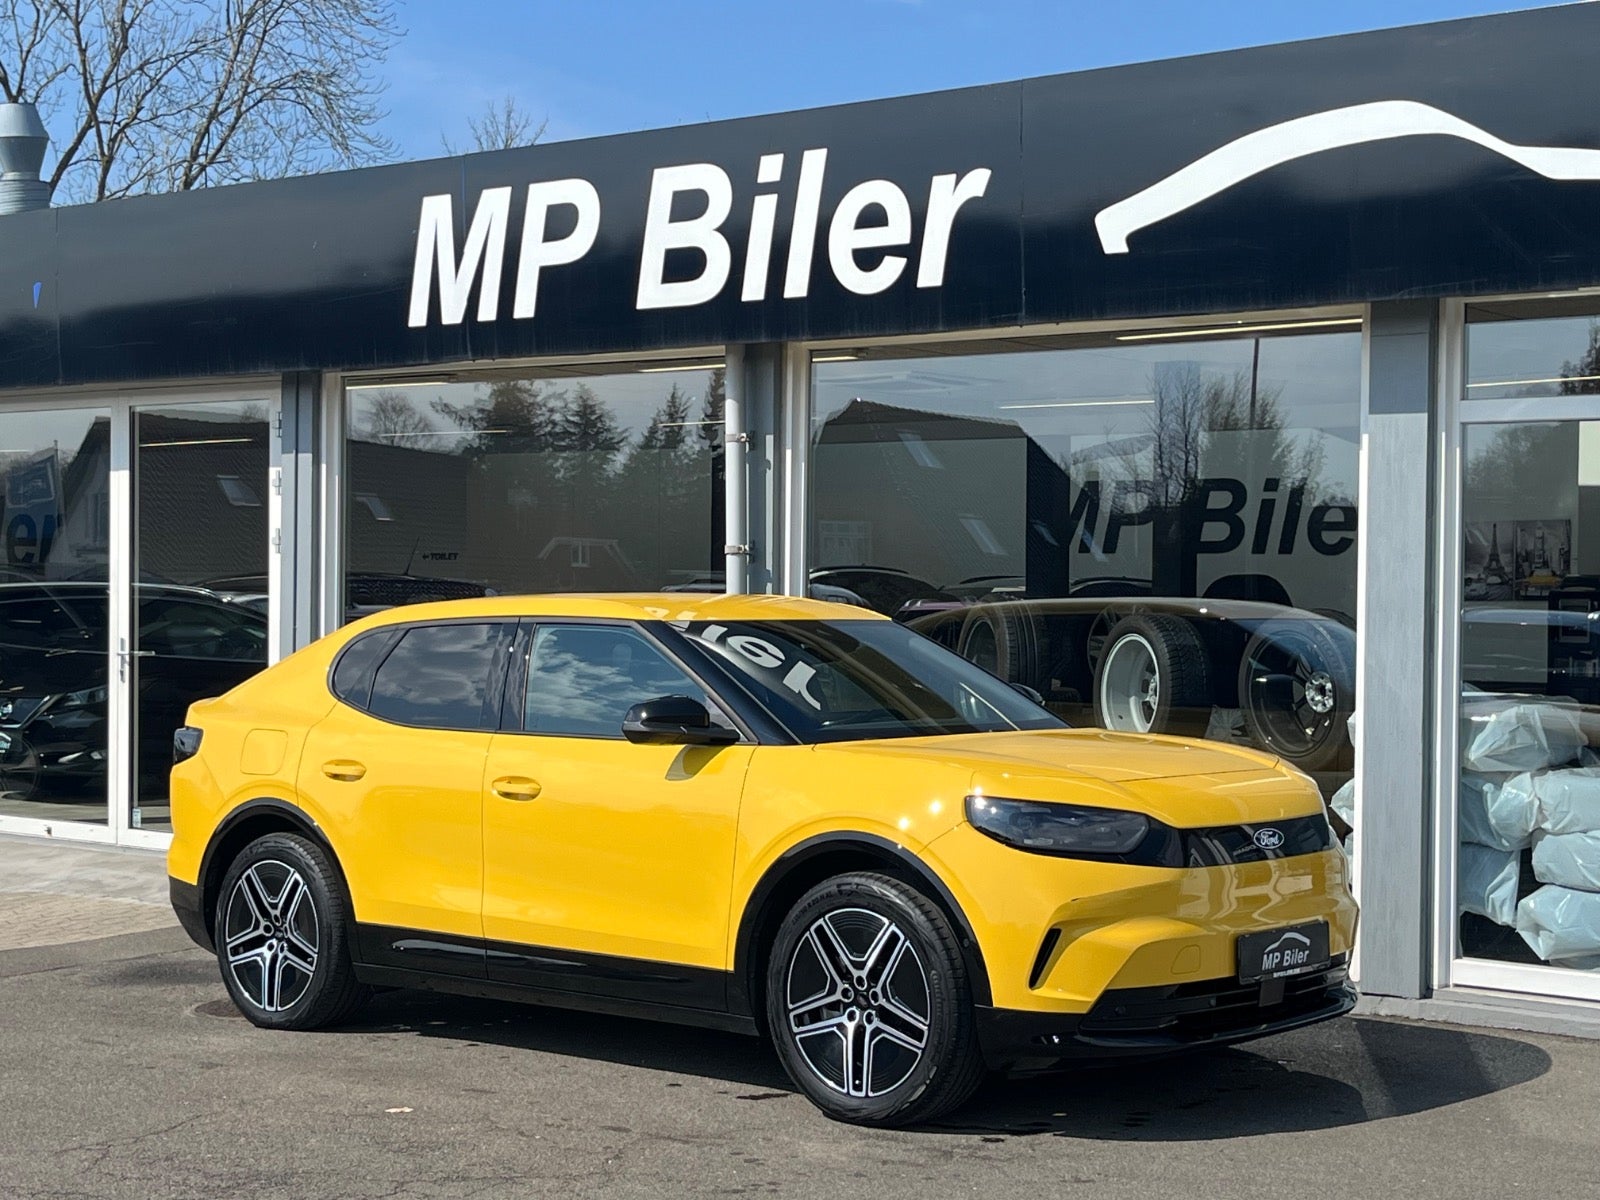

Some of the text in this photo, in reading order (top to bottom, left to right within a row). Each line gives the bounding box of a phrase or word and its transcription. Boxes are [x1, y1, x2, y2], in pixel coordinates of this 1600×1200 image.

[408, 148, 991, 328] MP Biler
[430, 552, 459, 560] TOILET
[1262, 948, 1310, 971] MP Biler
